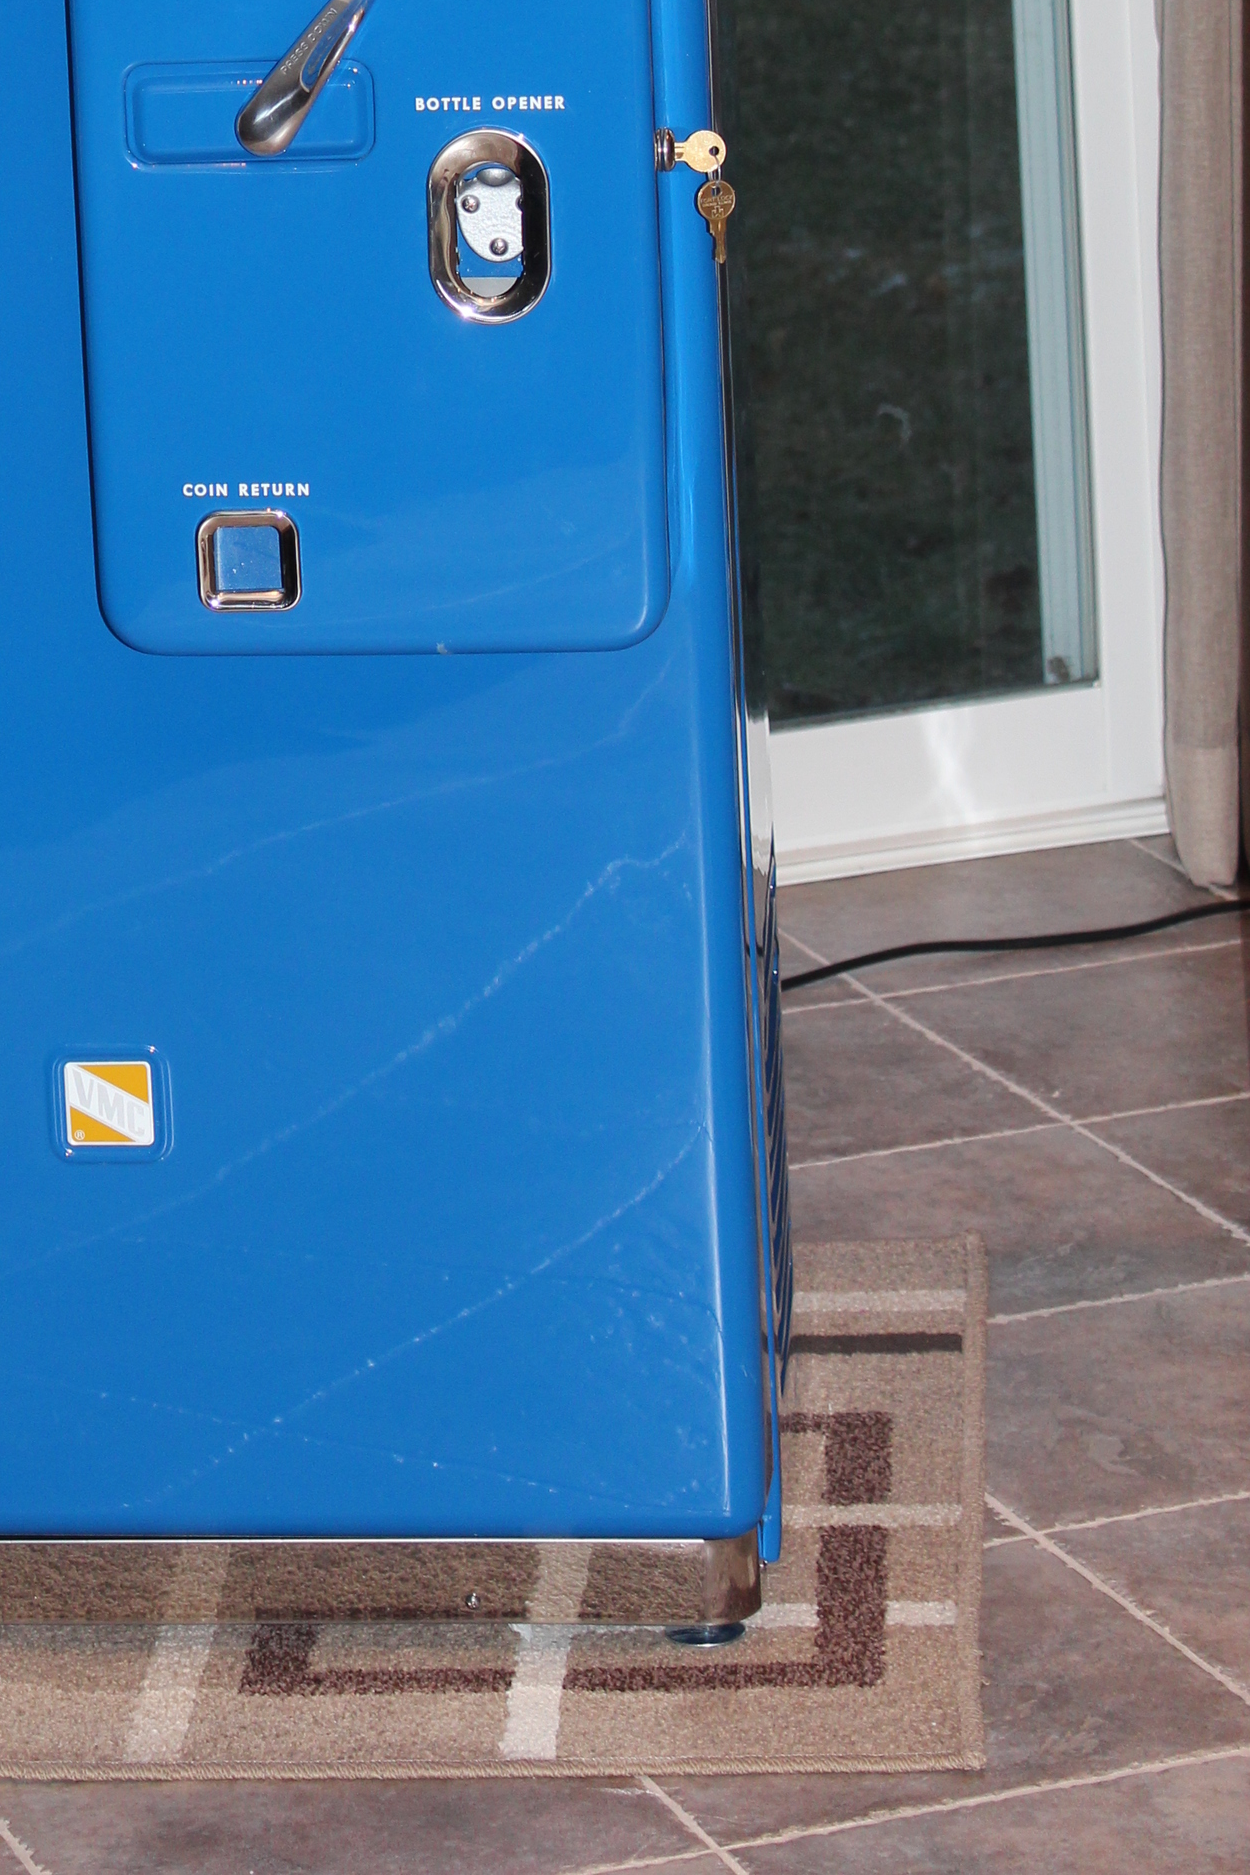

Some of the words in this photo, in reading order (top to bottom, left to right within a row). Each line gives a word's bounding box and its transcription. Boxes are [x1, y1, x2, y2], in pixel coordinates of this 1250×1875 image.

[415, 96, 481, 111] BOTTLE
[491, 95, 566, 110] OPENER
[182, 483, 228, 497] COIN
[238, 483, 310, 497] RETURN
[72, 1070, 145, 1136] VMC
